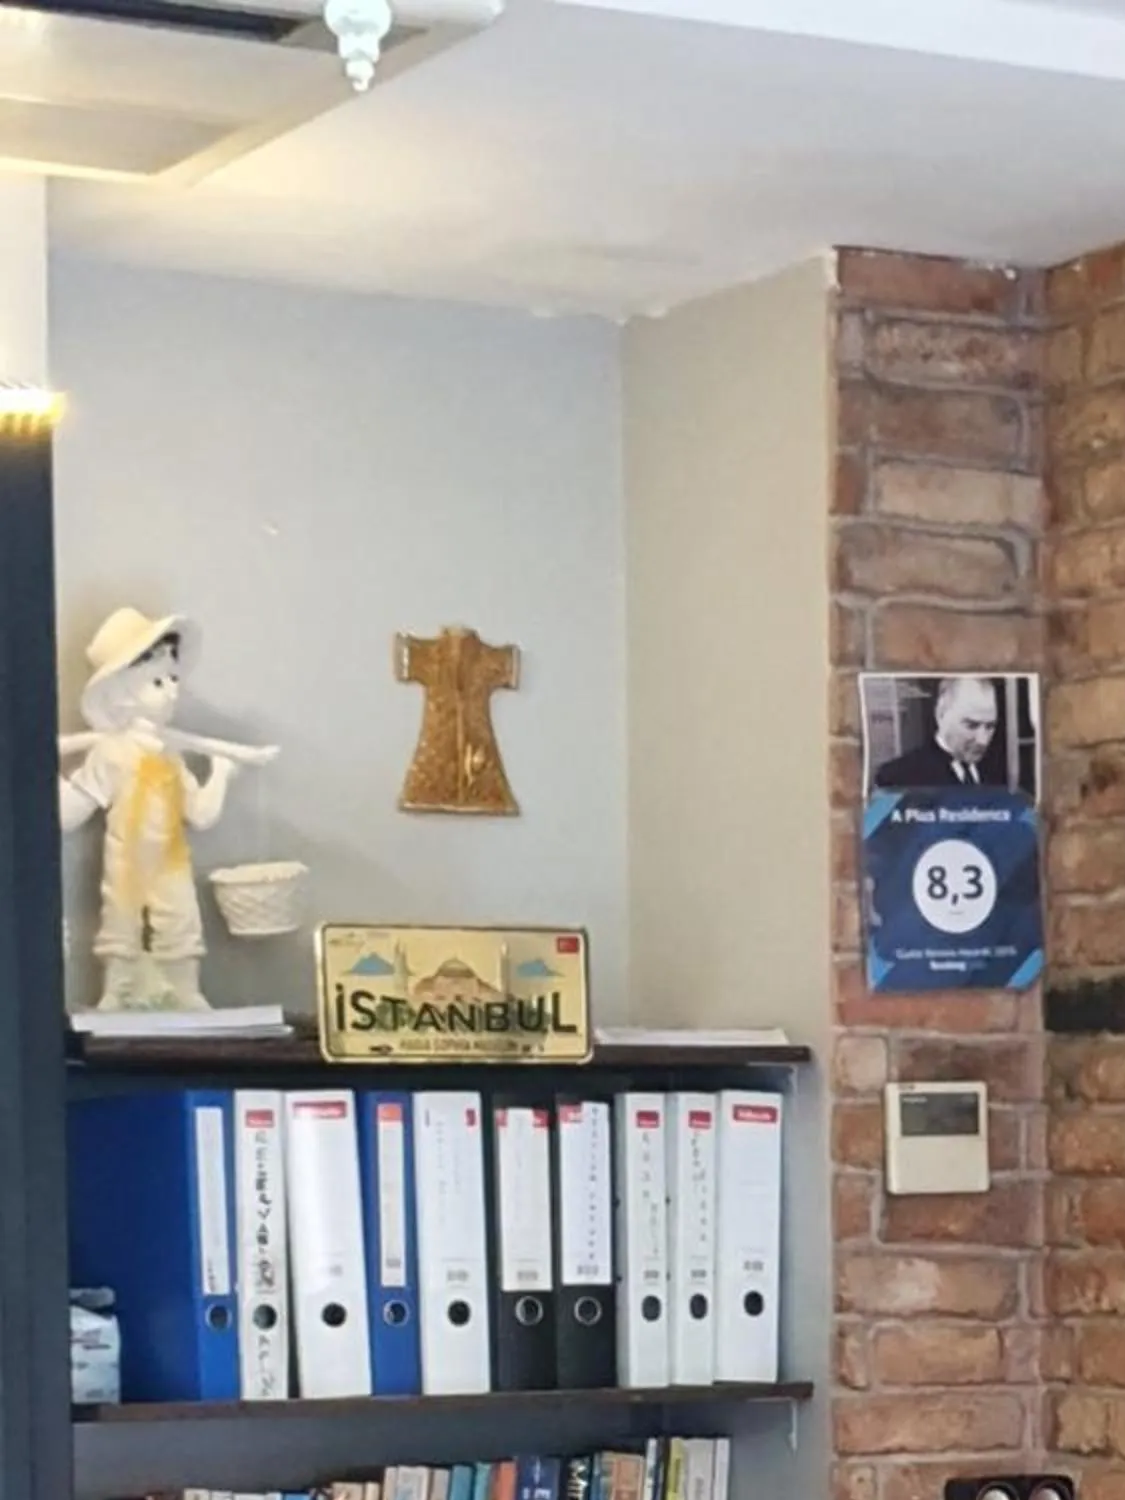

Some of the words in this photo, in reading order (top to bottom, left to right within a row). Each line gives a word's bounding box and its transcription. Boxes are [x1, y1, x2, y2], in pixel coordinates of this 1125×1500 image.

[891, 808, 902, 822] A
[904, 808, 935, 822] Plus
[927, 865, 984, 906] 8,3
